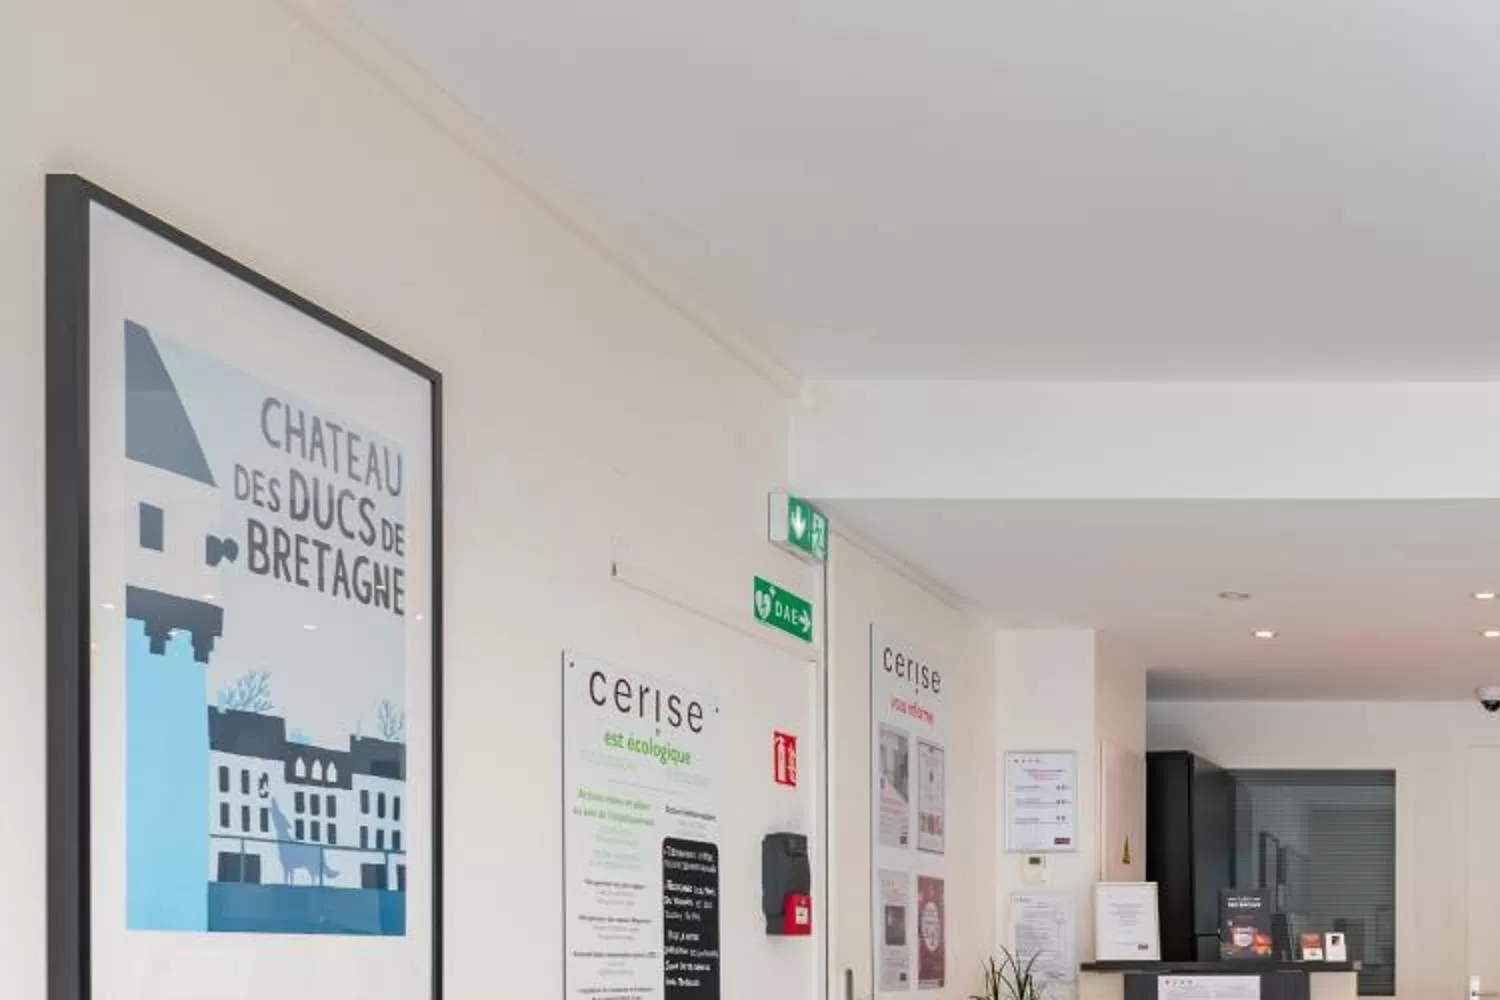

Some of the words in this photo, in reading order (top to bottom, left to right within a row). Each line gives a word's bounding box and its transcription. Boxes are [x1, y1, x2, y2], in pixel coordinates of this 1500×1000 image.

[261, 397, 402, 497] CHATEAU
[234, 463, 281, 513] DES
[289, 467, 376, 547] DUCS
[382, 517, 405, 557] DE
[248, 518, 405, 616] BRETAGNE
[775, 600, 798, 625] DAE
[589, 671, 703, 736] cerise
[883, 647, 941, 695] cerise
[604, 731, 624, 749] est
[627, 732, 692, 766] écologique
